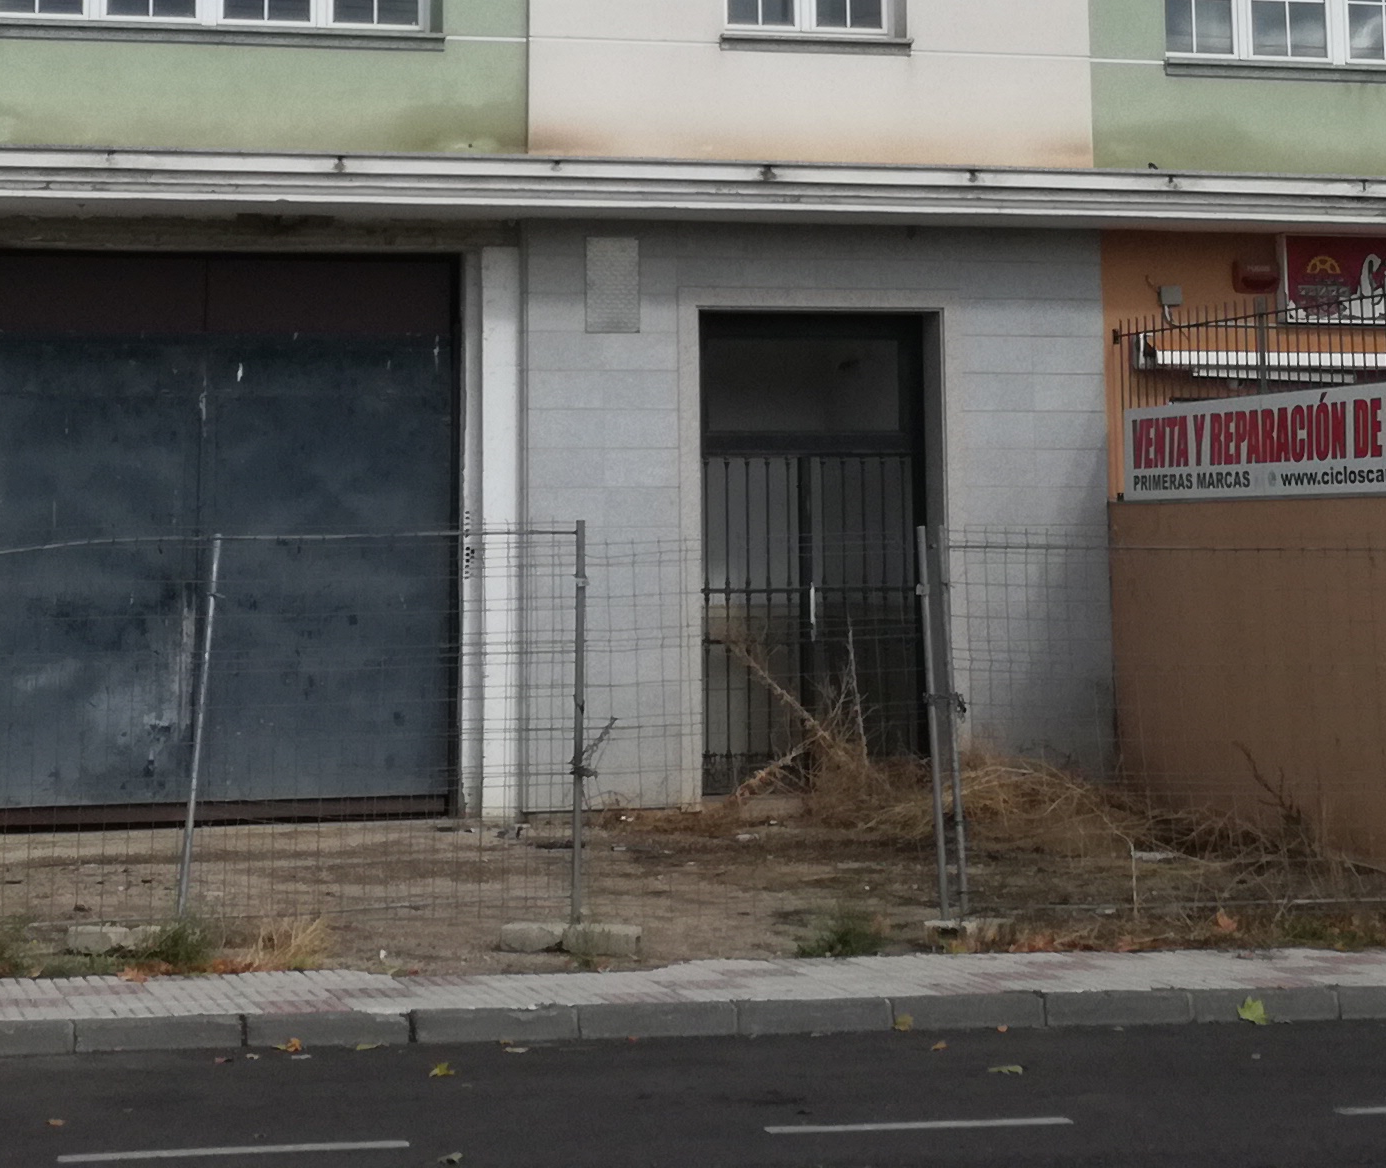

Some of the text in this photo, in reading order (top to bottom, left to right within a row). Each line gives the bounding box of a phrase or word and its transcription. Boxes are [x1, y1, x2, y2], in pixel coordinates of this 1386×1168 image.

[1131, 414, 1189, 470] VENTA
[1193, 414, 1208, 467] Y
[1211, 392, 1347, 466] REPARACIÓN
[1353, 398, 1383, 459] DE
[1133, 471, 1193, 491] PRIMERAS
[1196, 470, 1250, 489] MARCAS
